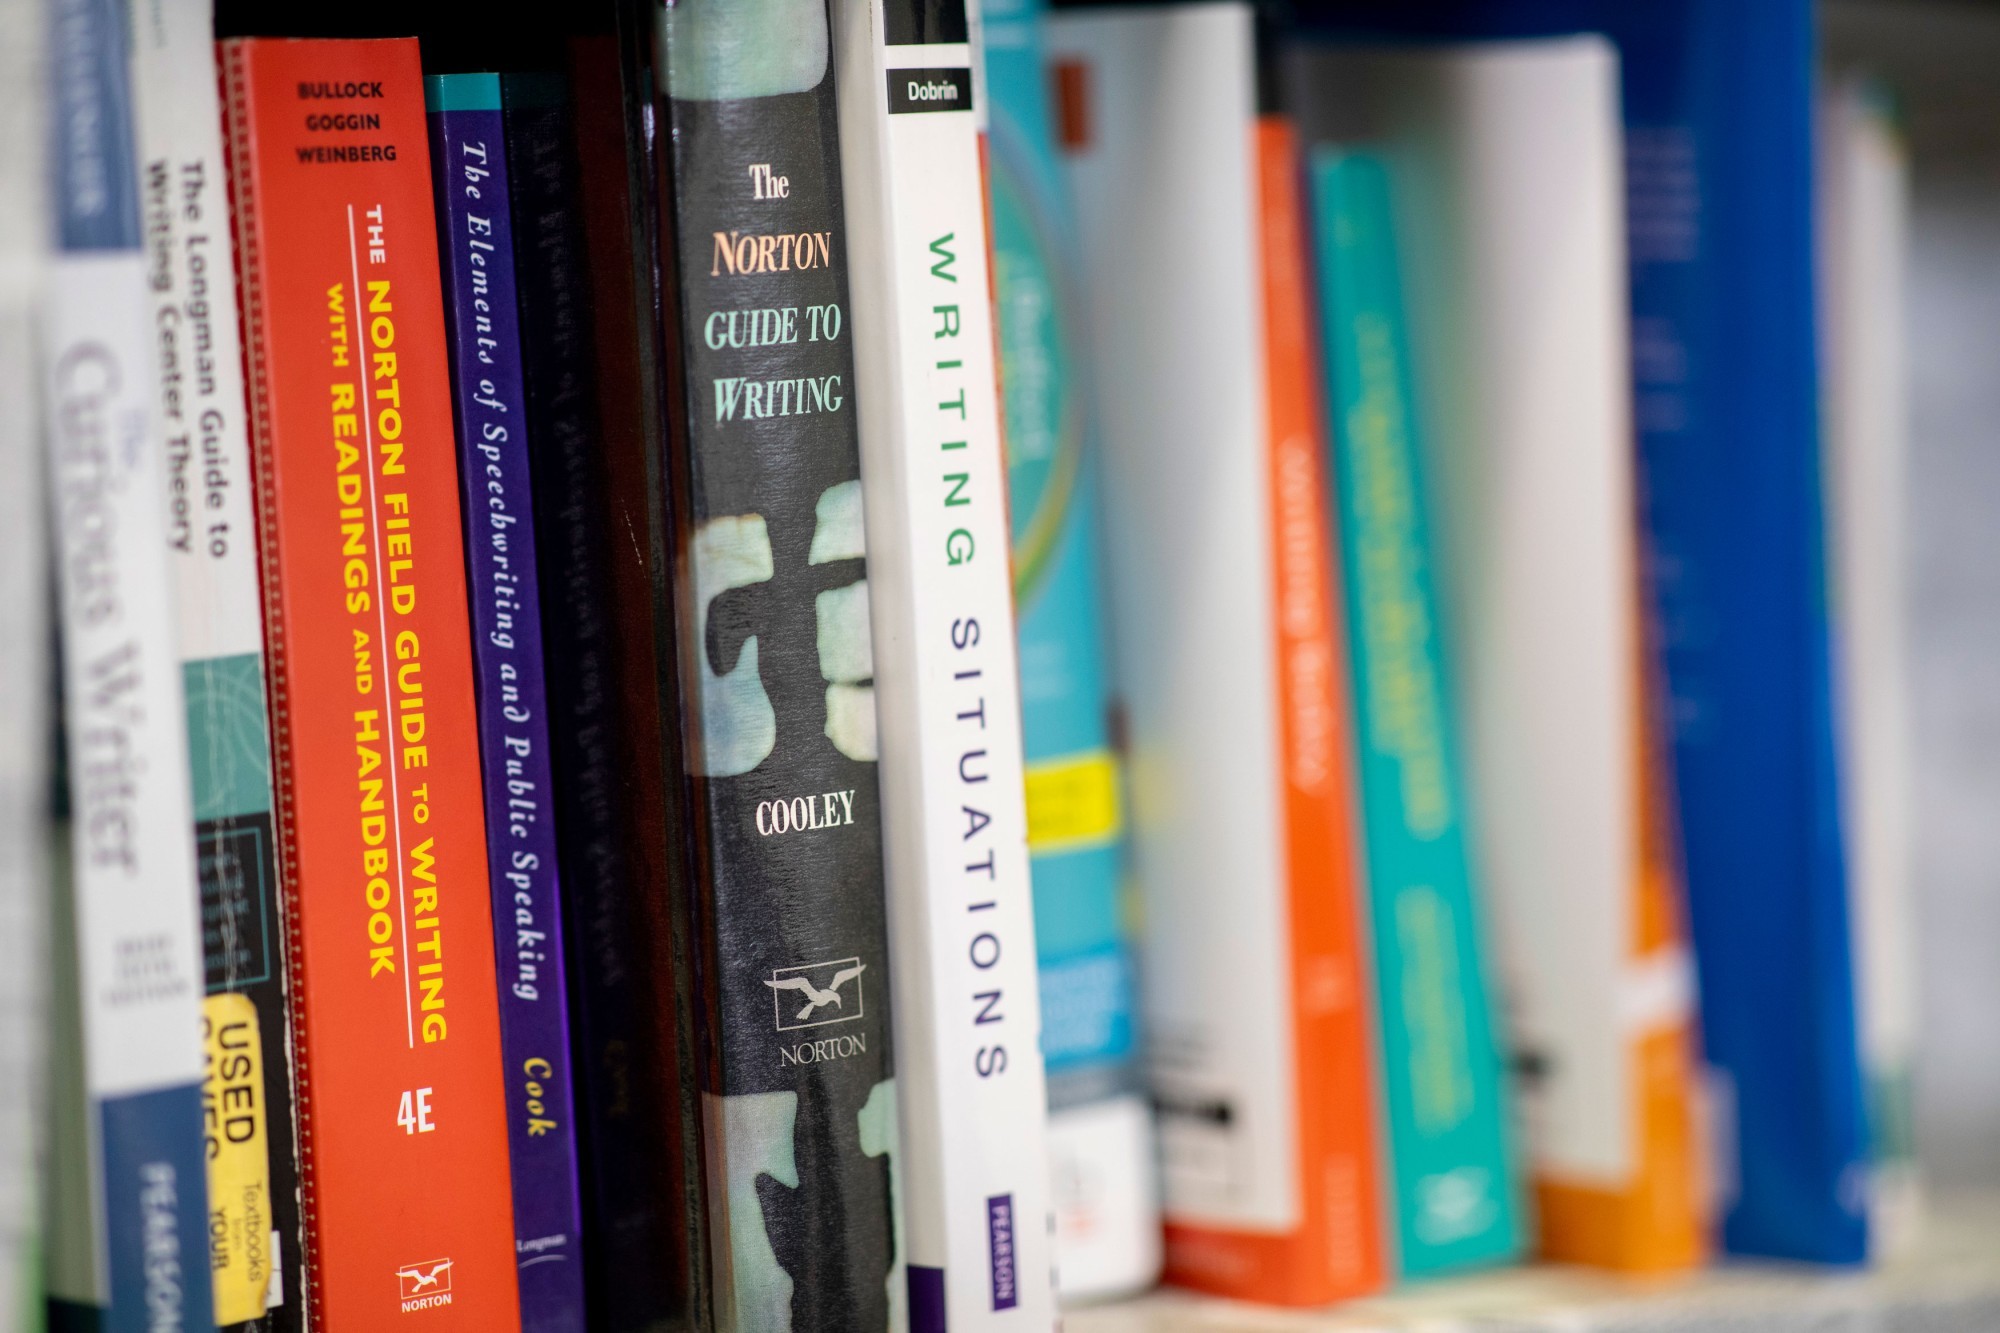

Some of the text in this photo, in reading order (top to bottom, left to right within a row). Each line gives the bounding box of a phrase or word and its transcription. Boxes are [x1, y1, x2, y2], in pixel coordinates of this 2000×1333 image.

[298, 82, 383, 99] BULLOCK
[908, 81, 957, 100] Dobrin
[306, 114, 380, 131] GOGGIN
[294, 145, 396, 164] WEINBERG
[749, 164, 789, 199] The
[712, 231, 831, 275] NORTON
[705, 304, 841, 349] GUIDE TO
[149, 161, 192, 553] Writing Center Theory
[182, 162, 229, 558] The Longman Guide to
[714, 376, 842, 421] WRITING
[463, 142, 545, 1000] The Elements of Speechwriting and Public Speaking
[328, 284, 394, 977] WITH READINGS AND HANDBOOK
[367, 205, 446, 1042] THE NORTON FIELD GUIDE TO WRITING
[930, 233, 1006, 1078] WRITING SITUATIONS
[89, 640, 148, 876] Writer
[756, 790, 855, 835] COOLEY
[780, 1033, 865, 1066] NORTON
[218, 1022, 256, 1143] USED
[524, 1058, 556, 1135] Cook
[396, 1087, 435, 1134] 4E
[211, 1207, 230, 1269] YOUR
[243, 1179, 265, 1282] Textbooks
[991, 1204, 1014, 1300] PEARSON
[402, 1294, 451, 1312] NORTON
